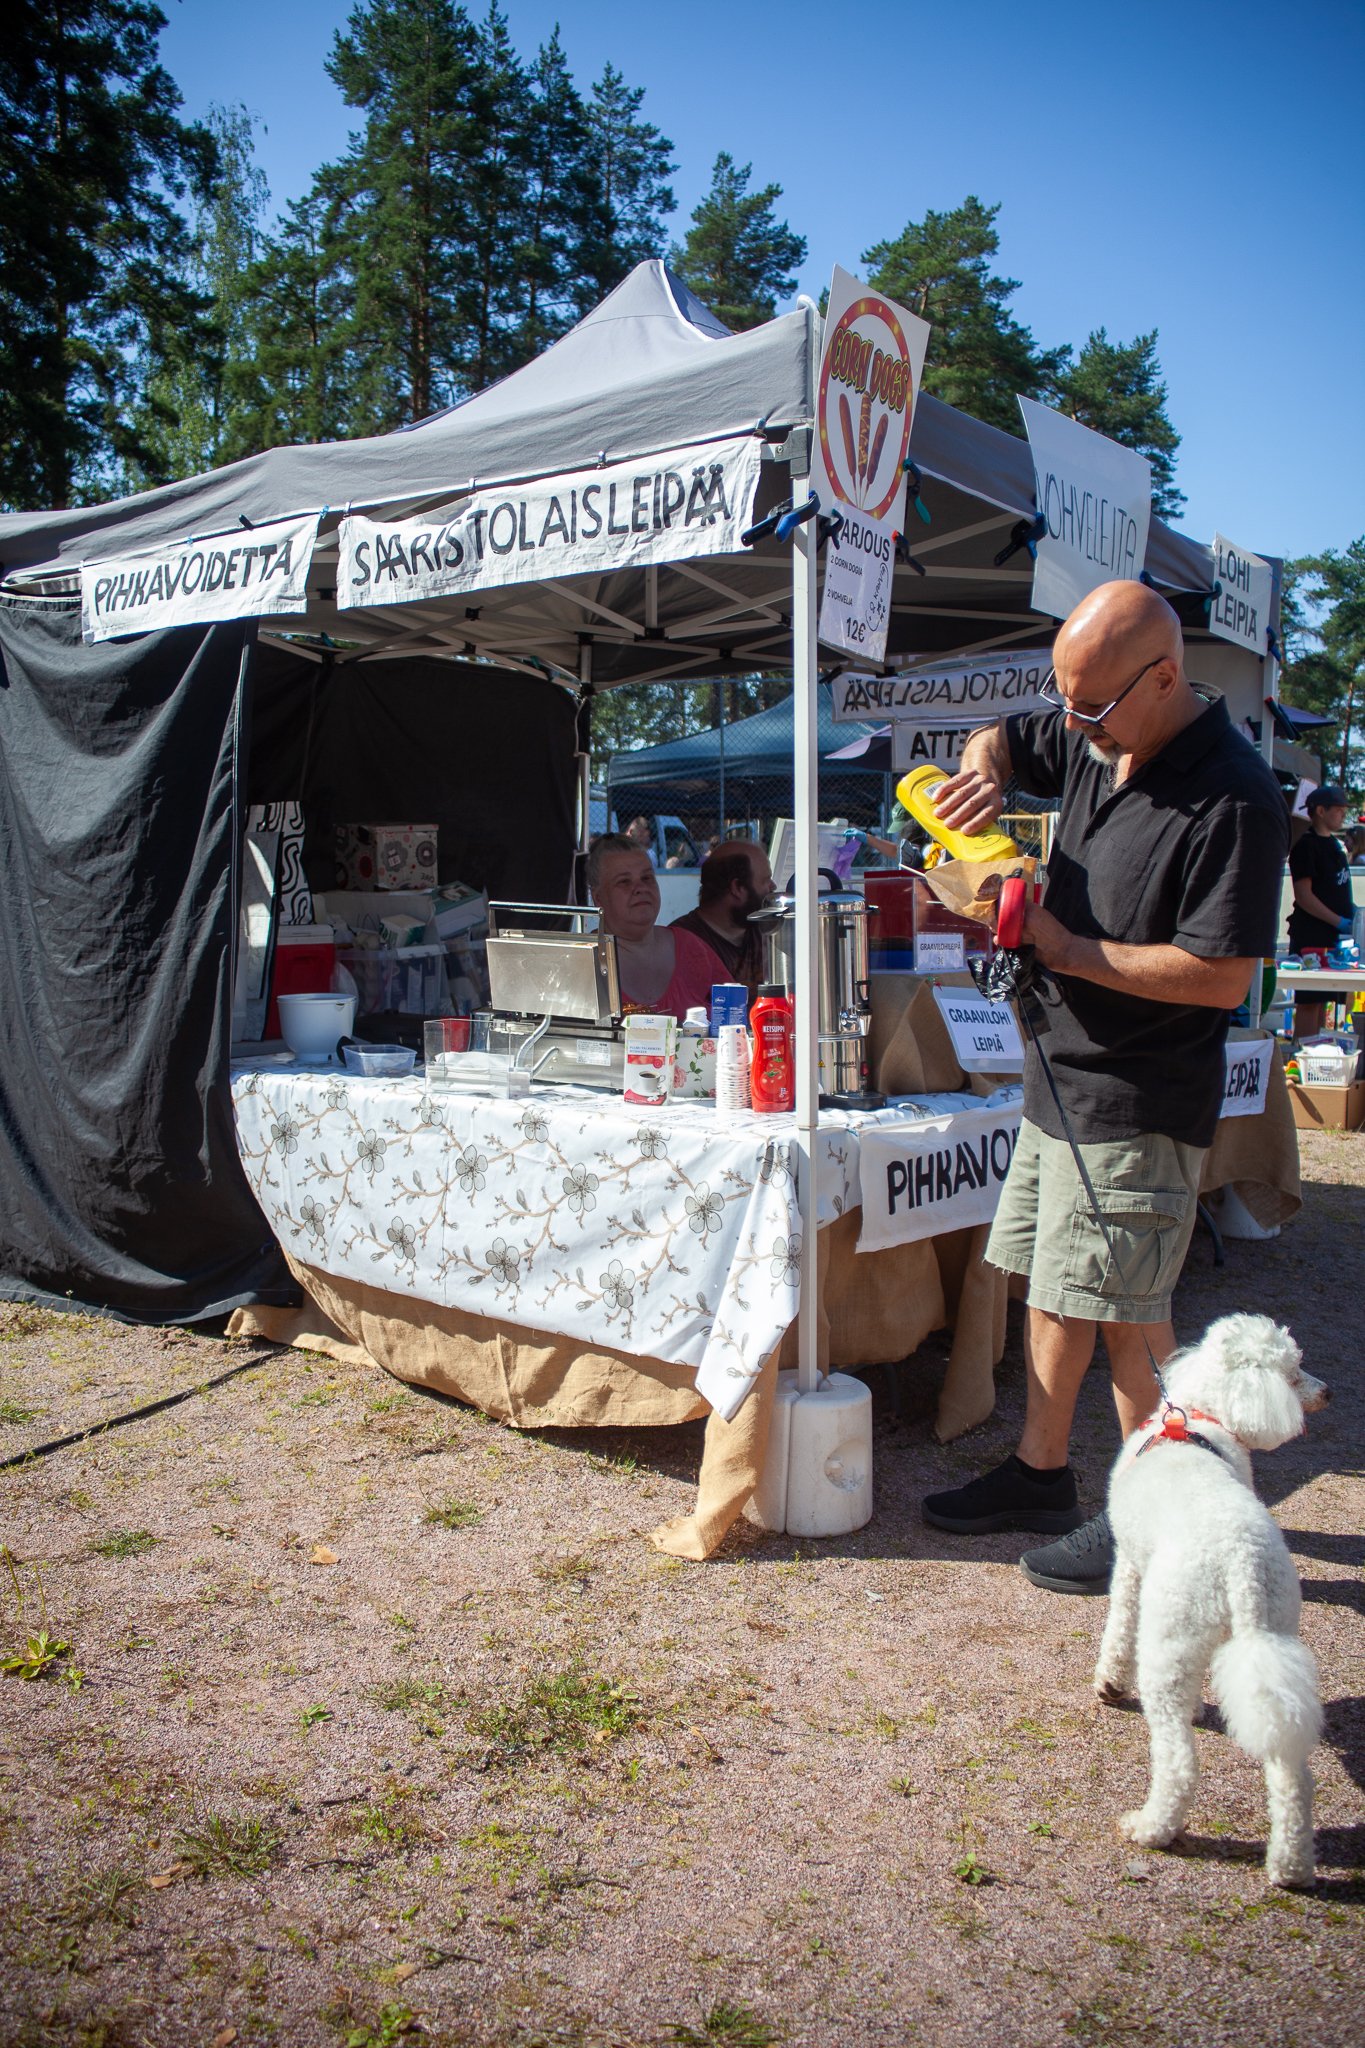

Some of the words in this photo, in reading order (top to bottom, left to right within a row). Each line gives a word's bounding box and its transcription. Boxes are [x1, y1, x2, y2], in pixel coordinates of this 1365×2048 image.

[830, 327, 875, 394] CORN
[869, 348, 911, 414] DOGS
[351, 463, 732, 587] SAARISTOLAISLEIPÄÄ
[837, 516, 890, 562] ARJOUS
[94, 540, 293, 616] PIHKAVOIDETTA
[1218, 544, 1250, 593] LOHI
[846, 616, 866, 643] 12€
[948, 1008, 1012, 1025] GRAAVILOHI
[972, 1034, 1004, 1052] LEIPIÄ
